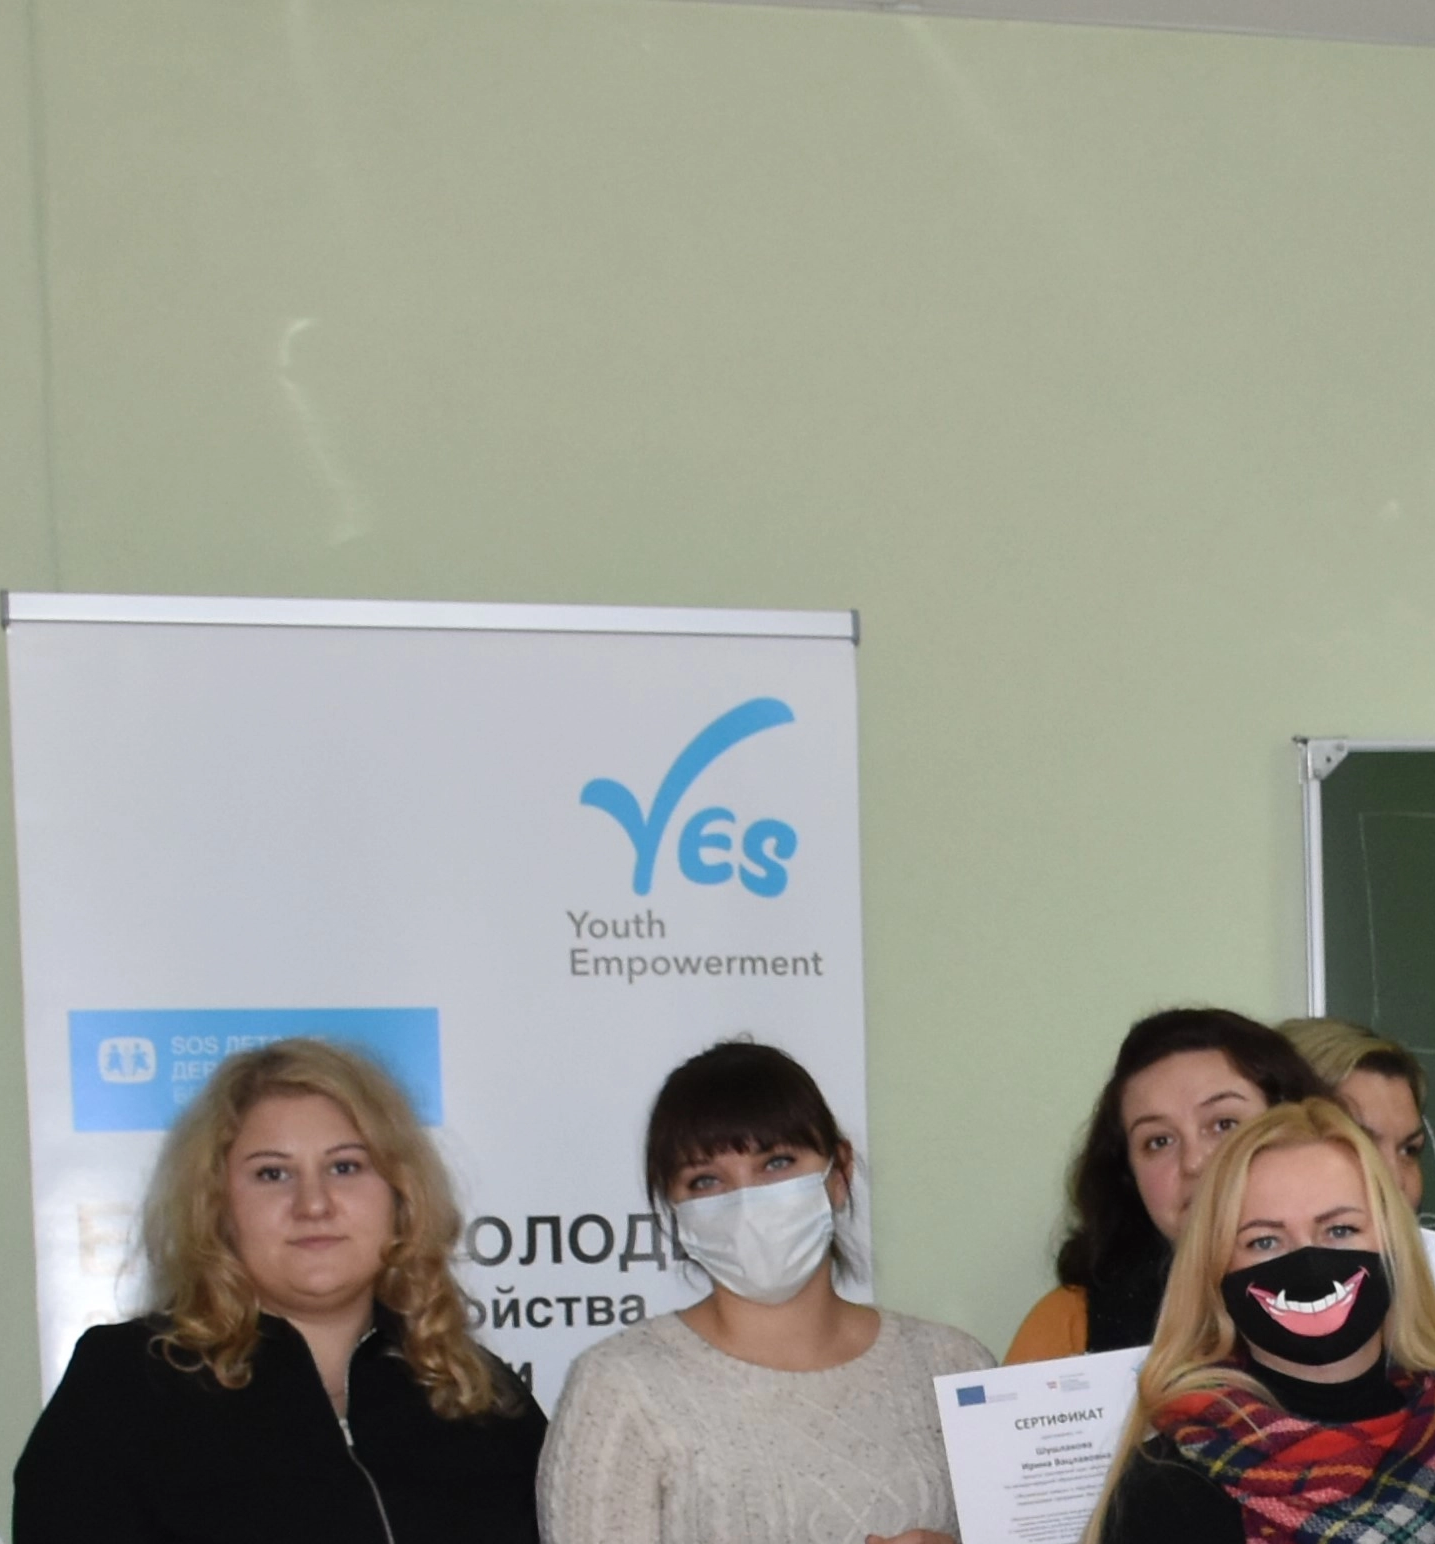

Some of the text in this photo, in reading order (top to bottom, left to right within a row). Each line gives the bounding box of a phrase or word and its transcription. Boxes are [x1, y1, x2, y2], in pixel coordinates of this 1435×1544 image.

[566, 909, 666, 939] Youth
[570, 948, 824, 985] Empowerment
[171, 1035, 219, 1055] SOS
[1014, 1407, 1103, 1431] СЕРТИФИКАТ
